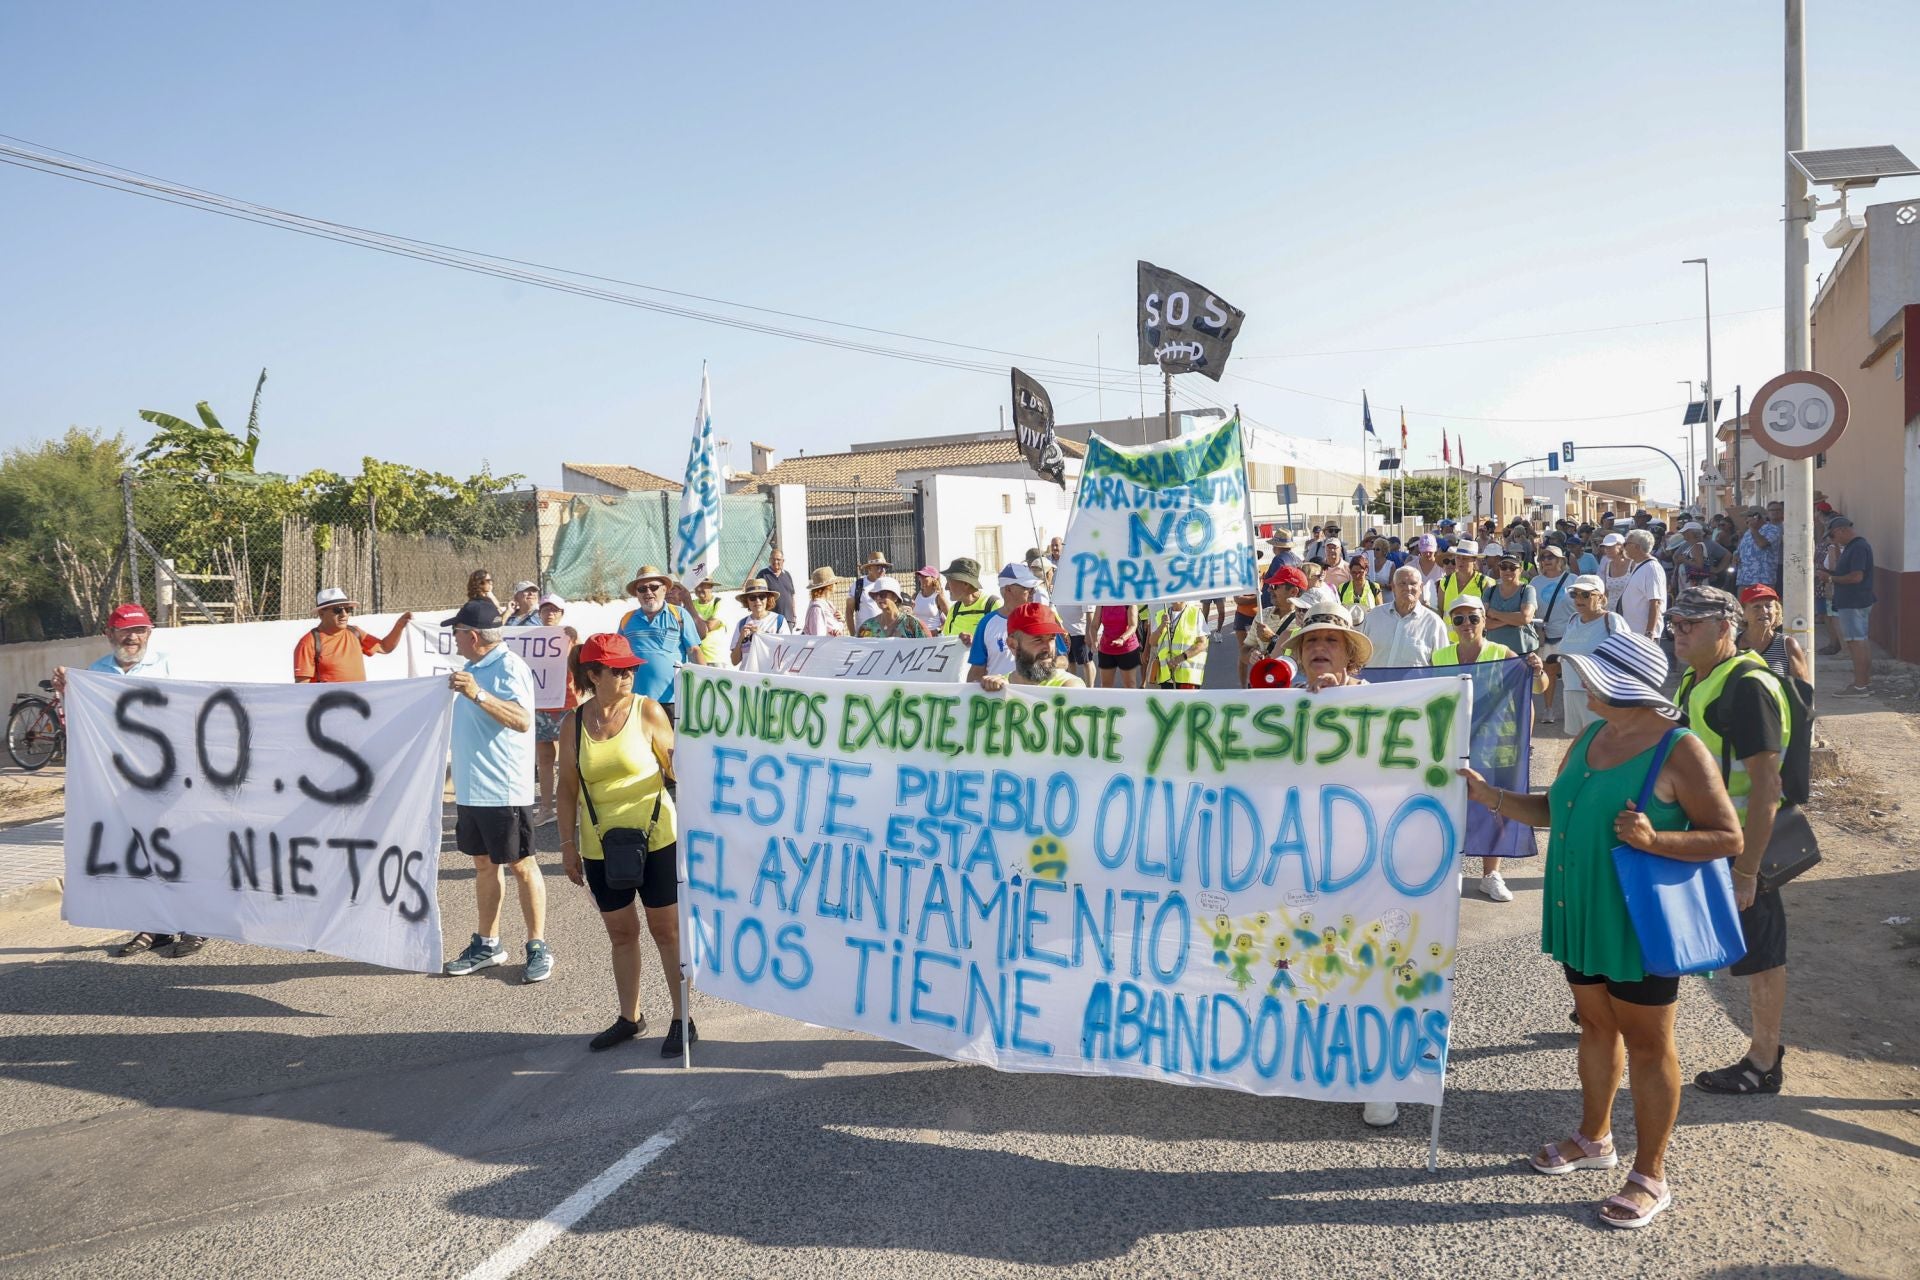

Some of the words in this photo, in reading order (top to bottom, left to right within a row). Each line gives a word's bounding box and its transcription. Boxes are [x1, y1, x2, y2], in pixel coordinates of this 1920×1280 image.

[1145, 291, 1228, 328] SOS
[1768, 398, 1829, 433] 30
[1078, 475, 1130, 511] PARA
[1127, 509, 1213, 558] NO
[1071, 551, 1160, 600] PARA
[423, 630, 452, 655] LO
[770, 644, 815, 673] NO
[836, 643, 956, 677] SOMOS
[680, 670, 733, 737] LOS
[711, 745, 873, 843] ESTE
[896, 764, 1079, 837] PUEBLO
[686, 830, 737, 900] EL
[886, 813, 1004, 880] ESTA
[85, 822, 183, 882] LOS
[228, 828, 430, 923] NIETOS
[690, 903, 814, 990] NOS
[1081, 980, 1450, 1088] ABANDONADOS
